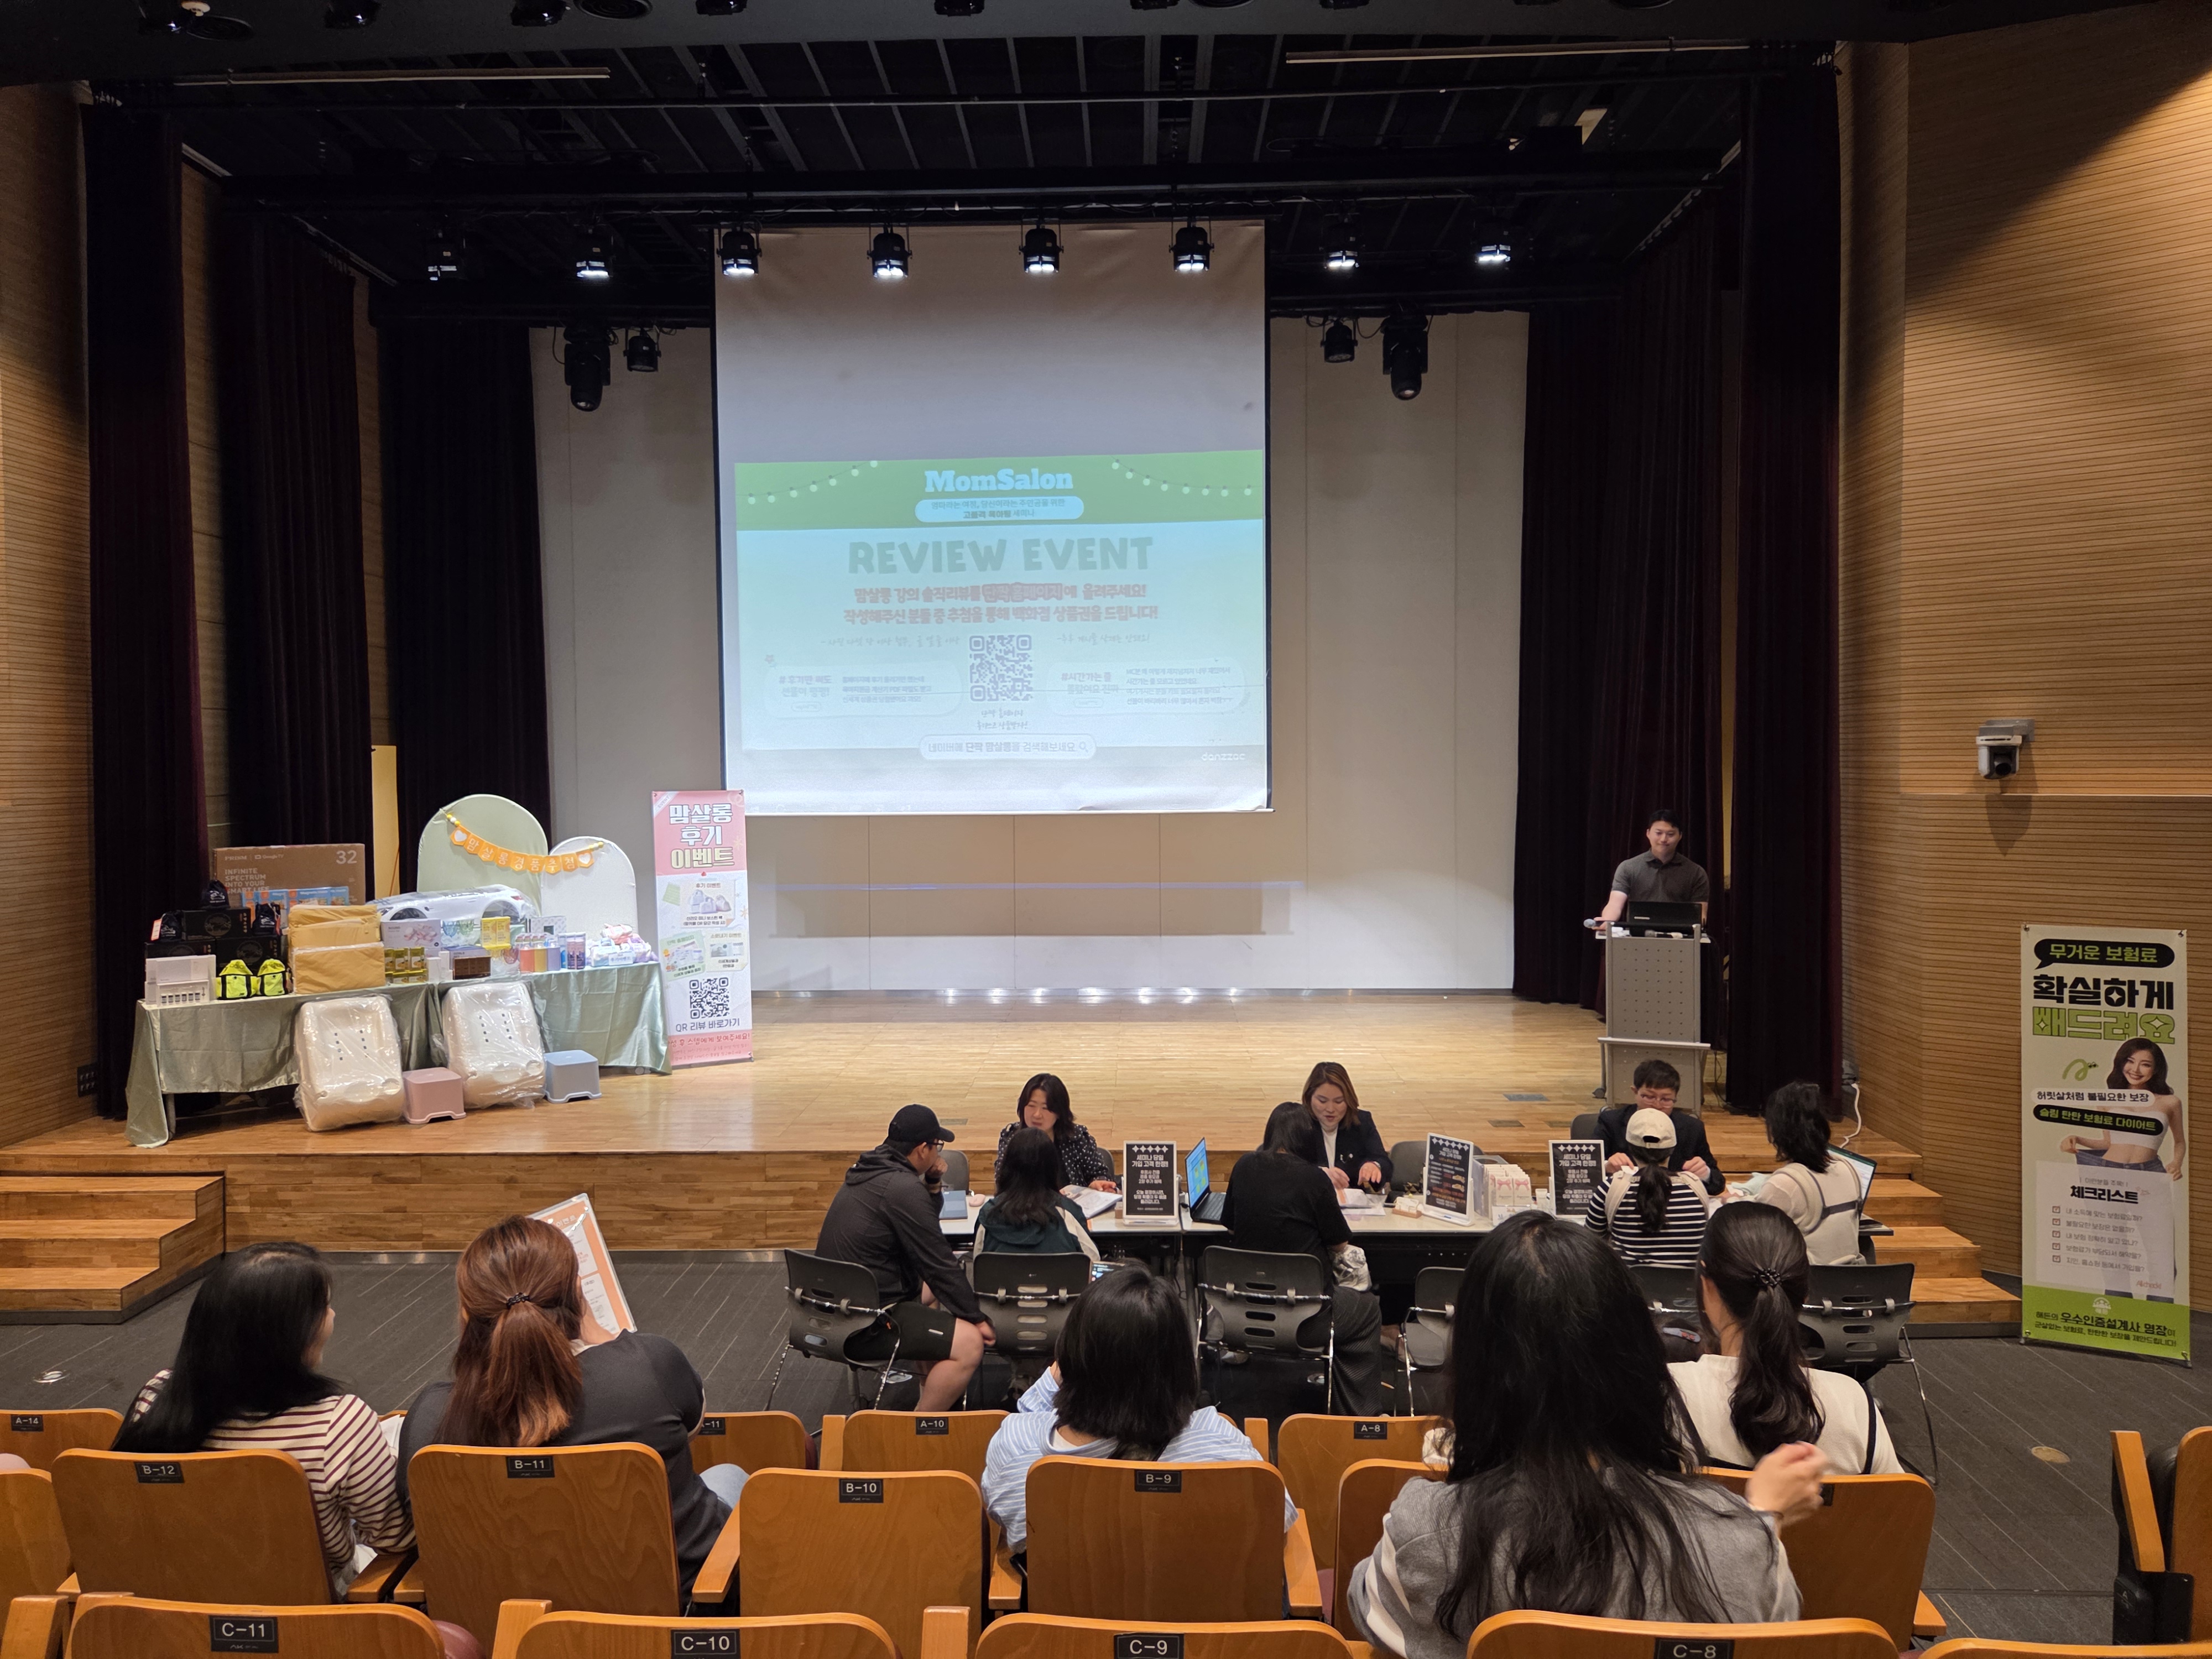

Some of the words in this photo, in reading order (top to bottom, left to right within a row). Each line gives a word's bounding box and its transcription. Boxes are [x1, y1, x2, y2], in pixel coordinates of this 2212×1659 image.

[925, 469, 1073, 492] MomSalon
[931, 502, 961, 510] 엄마라는
[981, 500, 1018, 509] 당신이라는
[1019, 499, 1049, 507] 주인공을
[1013, 509, 1034, 517] 세미나
[848, 539, 1006, 574] REVIEW
[1024, 536, 1153, 572] EVENT
[854, 588, 891, 603] 맘살롱
[894, 588, 919, 603] 강의
[922, 586, 980, 603] 솔직리뷰를
[1082, 583, 1146, 600] 올려주세요!
[843, 609, 905, 624] 작성해주신
[907, 608, 931, 624] 분들
[933, 607, 945, 624] 중
[947, 607, 983, 624] 추첨을
[985, 606, 1010, 623] 통해
[1012, 605, 1050, 623] 백화점
[1052, 605, 1102, 622] 상품권을
[1104, 606, 1158, 621] 드립니다!
[788, 675, 813, 685] 후기만
[928, 743, 963, 753] 네이버에
[966, 742, 983, 753] 단짝
[985, 742, 1020, 752] 맘살롱을
[1022, 742, 1076, 752] 검색해보세요
[1201, 752, 1246, 761] danzzac
[669, 803, 733, 825] 맘살롱
[680, 825, 723, 846] 후기
[336, 850, 358, 864] 32
[671, 847, 735, 870] 이벤트
[2049, 944, 2100, 960] 무거운
[2106, 946, 2158, 963] 보험료
[2033, 974, 2174, 1010] 확실하게
[676, 1023, 687, 1032] QR
[690, 1021, 706, 1031] 리뷰
[708, 1018, 740, 1029] 바로가기
[2032, 1006, 2176, 1045] 빼드려요
[668, 1039, 677, 1048] 성
[680, 1039, 685, 1047] 후
[716, 1032, 750, 1042] 보여주세요!
[2037, 1091, 2084, 1101] 허릿살처럼
[2088, 1092, 2126, 1102] 불필요한
[2129, 1093, 2149, 1102] 보장
[2039, 1108, 2059, 1118] 슬림
[2062, 1110, 2081, 1121] 탄탄
[2084, 1113, 2113, 1125] 보험료
[2115, 1118, 2157, 1131] 다이어트
[2070, 1185, 2139, 1204] 체크리스트
[2074, 1208, 2092, 1217] 소득에
[2060, 1312, 2140, 1333] 우수인증설계사
[2144, 1322, 2176, 1337] 명장이
[2088, 1328, 2108, 1337] 탄탄한
[2110, 1331, 2131, 1341] 보장을
[143, 1465, 176, 1475] B-12
[514, 1460, 545, 1469] B-11
[1145, 1474, 1172, 1484] B-9
[846, 1483, 877, 1493] B-10
[222, 1623, 265, 1637] C-11
[681, 1636, 730, 1651] C-10
[1129, 1640, 1168, 1655] C-9
[1673, 1644, 1717, 1658] C-8
